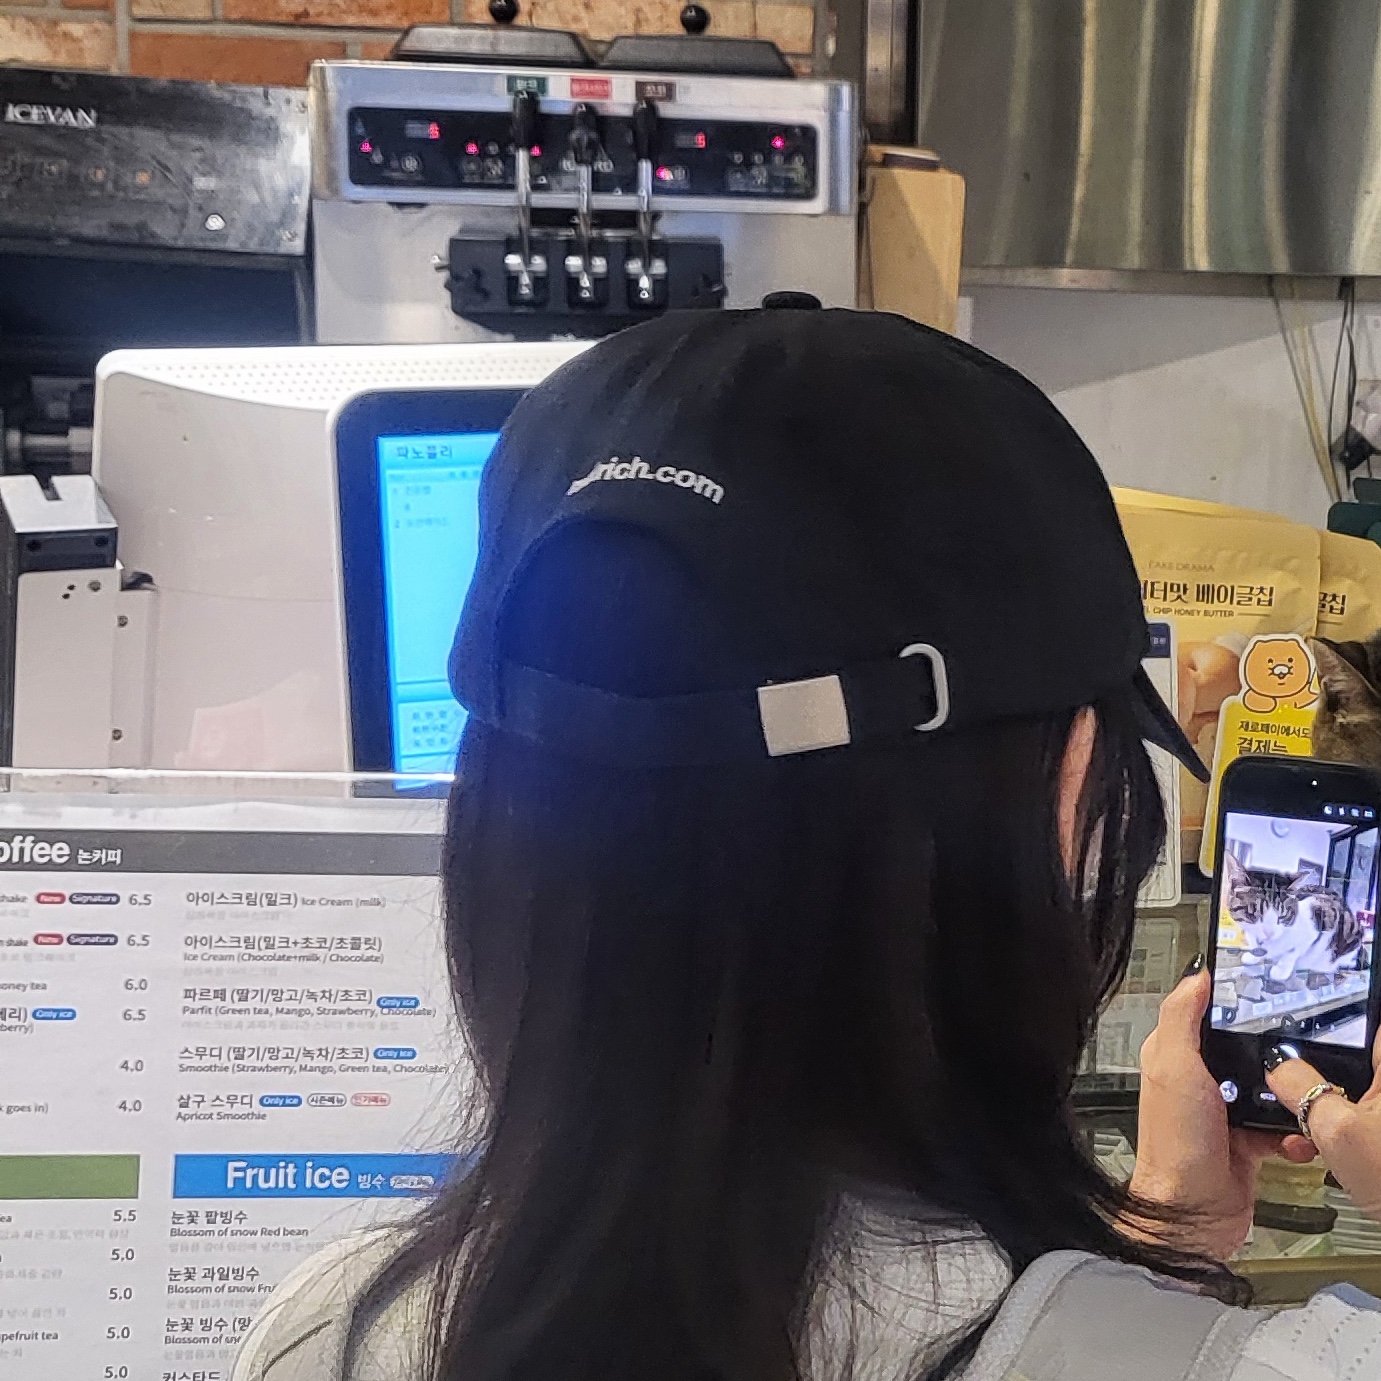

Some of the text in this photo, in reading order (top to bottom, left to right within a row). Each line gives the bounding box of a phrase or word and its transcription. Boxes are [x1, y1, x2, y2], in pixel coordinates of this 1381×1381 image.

[1174, 608, 1201, 617] HONEY
[1203, 609, 1235, 618] BUTTER
[128, 893, 153, 907] 6.5
[185, 891, 299, 908] 아이스크림(밀크)
[318, 898, 353, 907] Cream
[126, 934, 151, 947] 6.5
[183, 952, 199, 962] Ice
[200, 953, 235, 962] Cream
[124, 978, 149, 991] 6.0
[123, 1008, 147, 1021] 6.5
[182, 1006, 213, 1016] Parfit
[215, 1006, 251, 1017] (Green
[275, 1006, 315, 1018] Mango,
[316, 1006, 378, 1018] Strawberry,
[178, 1047, 223, 1061] 스무디
[119, 1059, 144, 1073] 4.0
[178, 1063, 370, 1074] Smoothie (Strawberry, Mango, Green
[118, 1099, 143, 1113] 4.0
[178, 1094, 254, 1109] 살구 스무디
[176, 1111, 267, 1122] Apricot Smoothie
[226, 1160, 297, 1190] Fruit
[304, 1161, 351, 1189] ice
[112, 1208, 137, 1223] 5.5
[171, 1210, 201, 1225] 눈꽃
[169, 1226, 309, 1238] Blossom of snow Red bean
[110, 1247, 135, 1262] 5.0
[167, 1266, 260, 1283] 눈꽃 과일빙수
[108, 1287, 133, 1301] 5.0
[167, 1283, 256, 1295] Blossom of snow
[165, 1317, 229, 1333] 눈꽃 빙수
[41, 1326, 131, 1341] tea 5.0
[164, 1334, 223, 1346] Blossom of
[103, 1365, 128, 1380] 5.0
